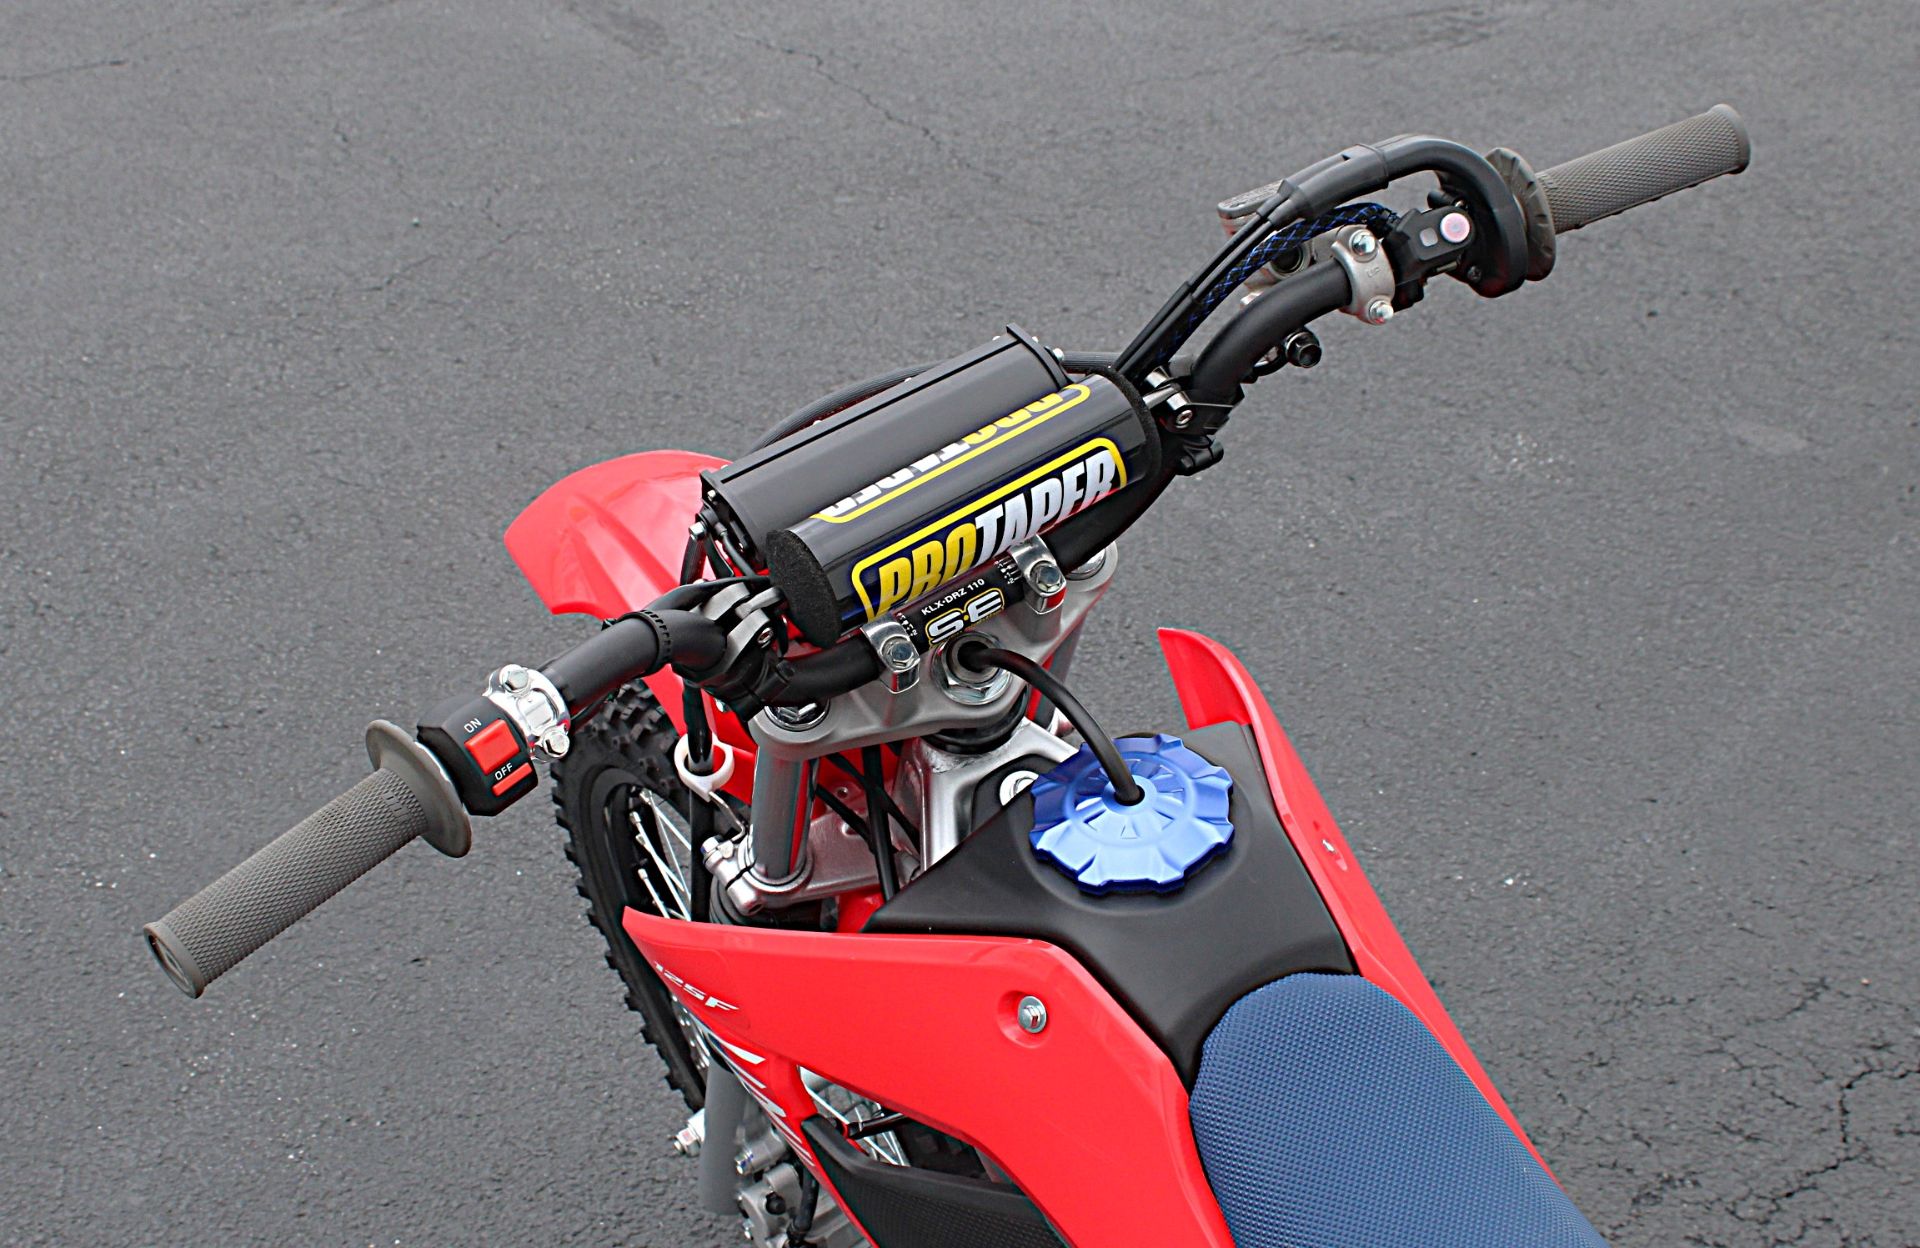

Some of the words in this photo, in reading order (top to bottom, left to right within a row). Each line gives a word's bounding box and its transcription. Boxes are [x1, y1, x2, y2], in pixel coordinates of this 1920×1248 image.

[967, 578, 985, 591] 110
[463, 717, 482, 733] ON
[494, 762, 513, 781] OFF
